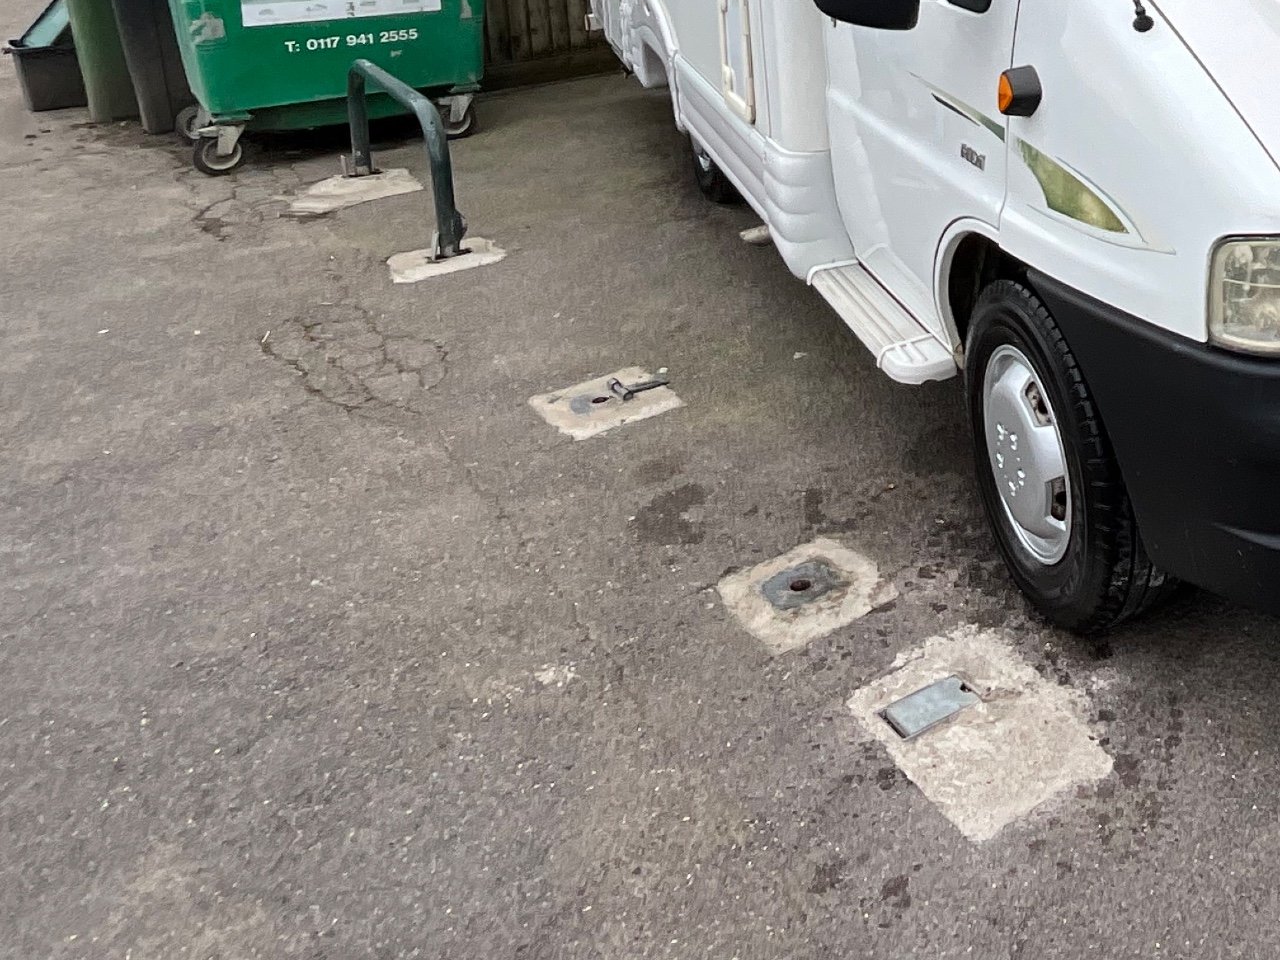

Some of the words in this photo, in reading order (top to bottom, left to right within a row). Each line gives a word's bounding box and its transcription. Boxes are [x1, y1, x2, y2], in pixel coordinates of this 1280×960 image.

[284, 40, 300, 53] T:
[306, 36, 340, 51] 0117
[346, 33, 374, 46] 941
[380, 28, 418, 43] 2555
